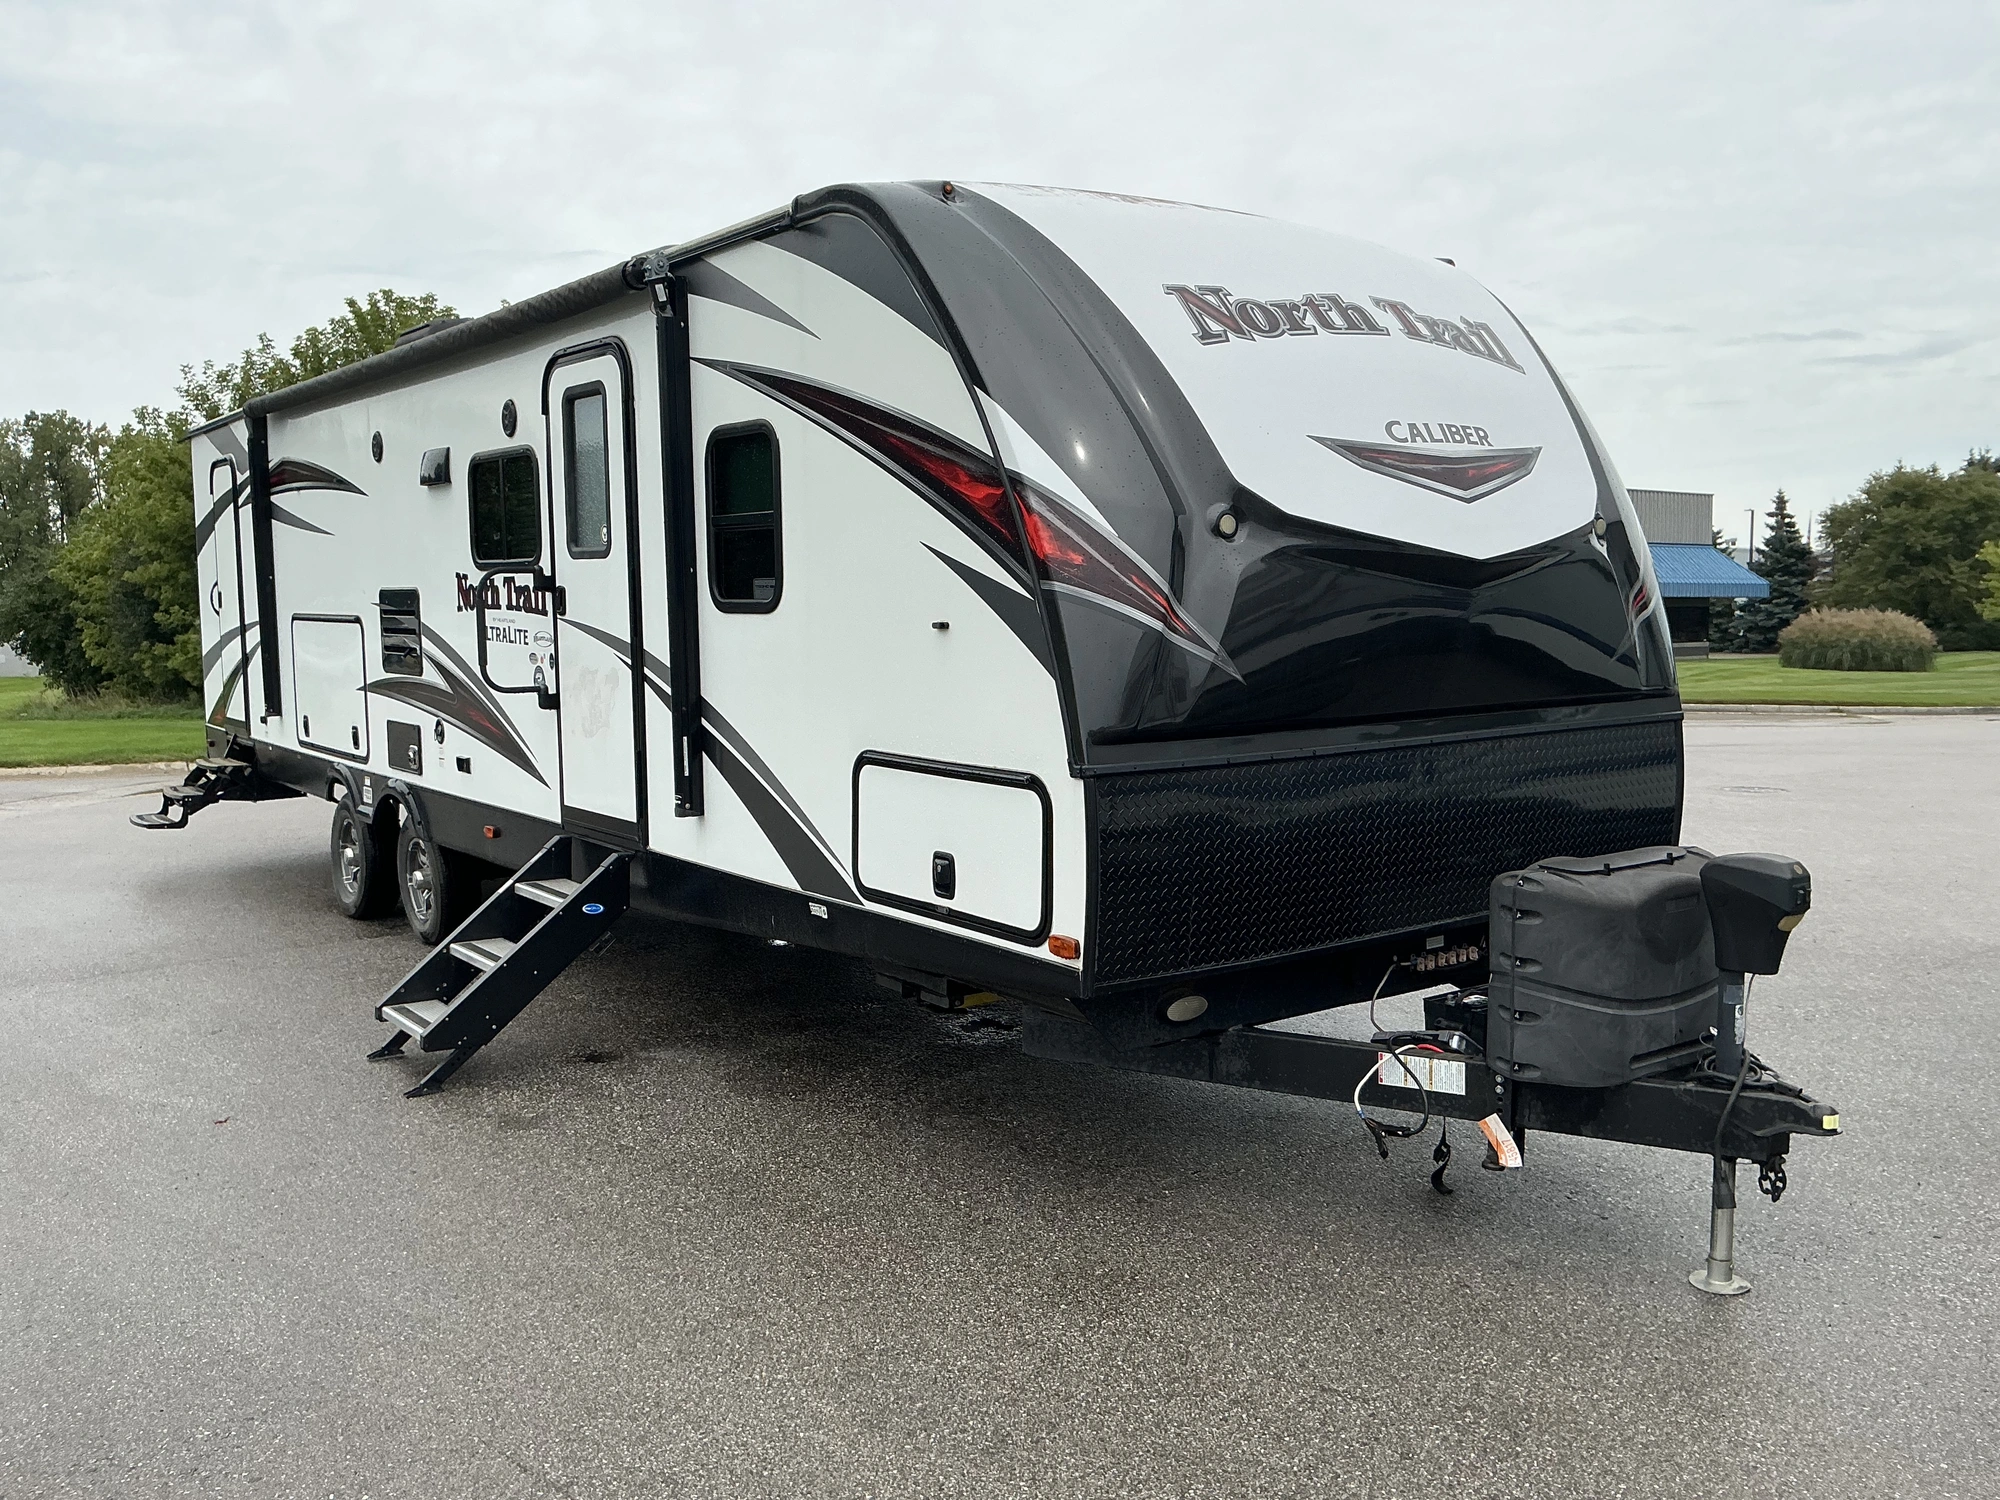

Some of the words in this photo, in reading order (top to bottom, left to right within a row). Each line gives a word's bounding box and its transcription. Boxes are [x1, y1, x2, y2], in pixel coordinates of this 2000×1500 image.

[1162, 283, 1391, 346] North
[1368, 295, 1527, 375] Trail
[1384, 420, 1494, 447] CALIBER
[455, 571, 502, 612] Noth
[503, 575, 549, 617] Trail
[486, 625, 529, 645] LTRALITE
